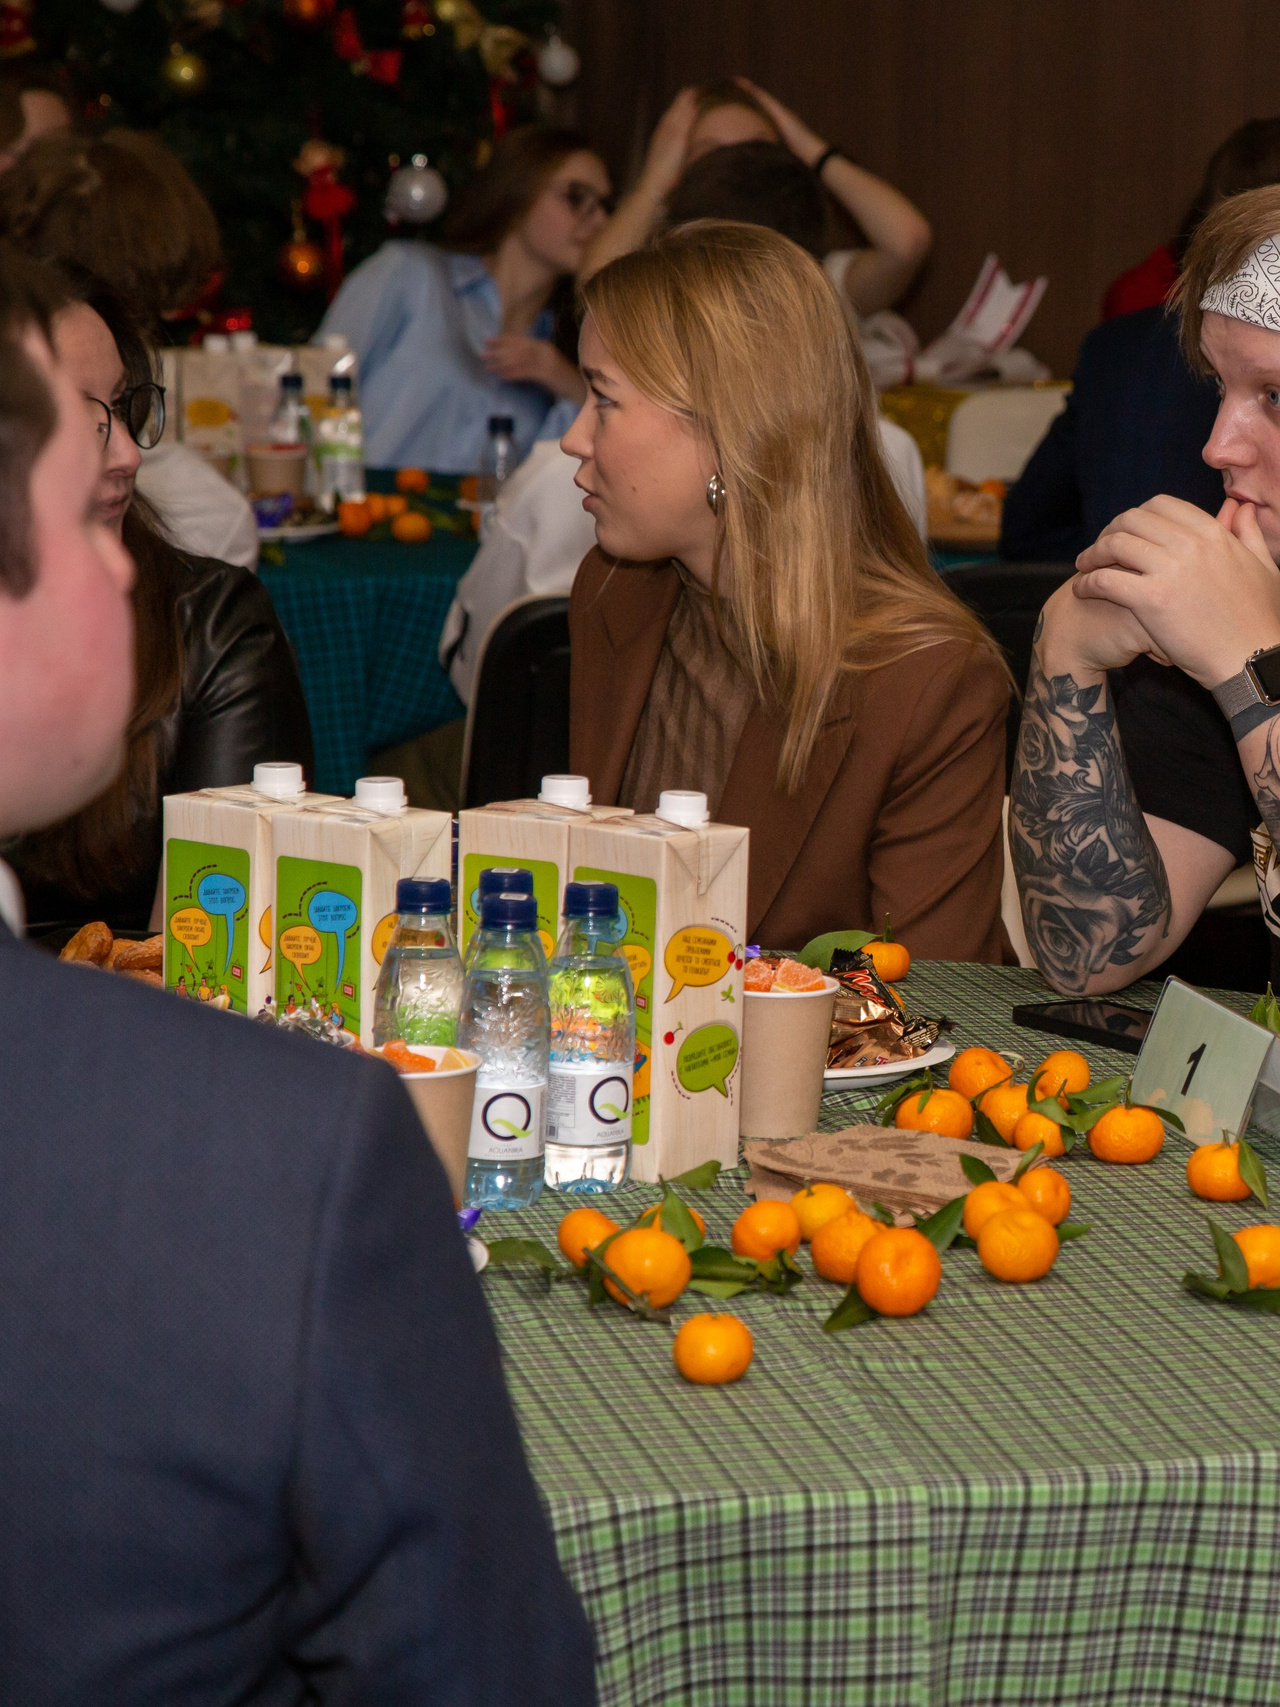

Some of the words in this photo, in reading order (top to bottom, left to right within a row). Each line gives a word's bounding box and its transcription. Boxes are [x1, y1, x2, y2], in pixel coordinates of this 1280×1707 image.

[1181, 1043, 1207, 1096] 1
[481, 1092, 533, 1142] Q
[588, 1076, 629, 1125] Q
